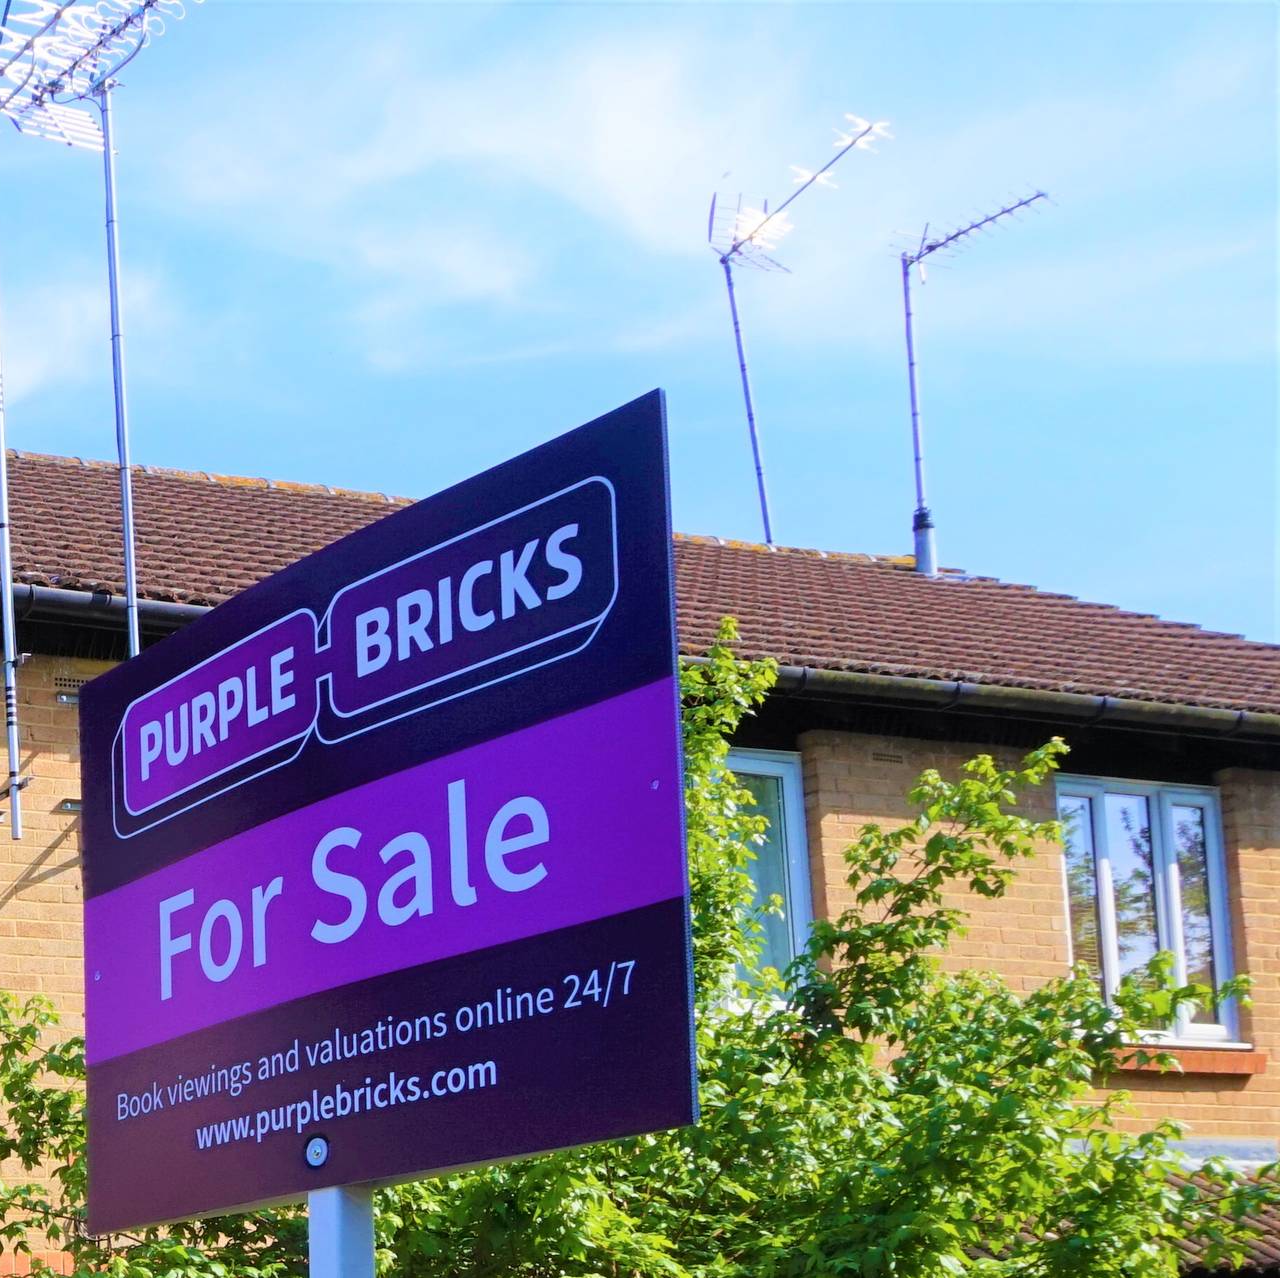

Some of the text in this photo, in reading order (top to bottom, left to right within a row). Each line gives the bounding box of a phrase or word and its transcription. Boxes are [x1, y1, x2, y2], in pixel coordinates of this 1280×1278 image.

[140, 523, 583, 782] PURPLE BRICKS
[159, 778, 550, 1001] For Sale
[117, 960, 635, 1121] Book viewings and valuations online 24/7
[196, 1060, 497, 1150] www.purplebricks.com
